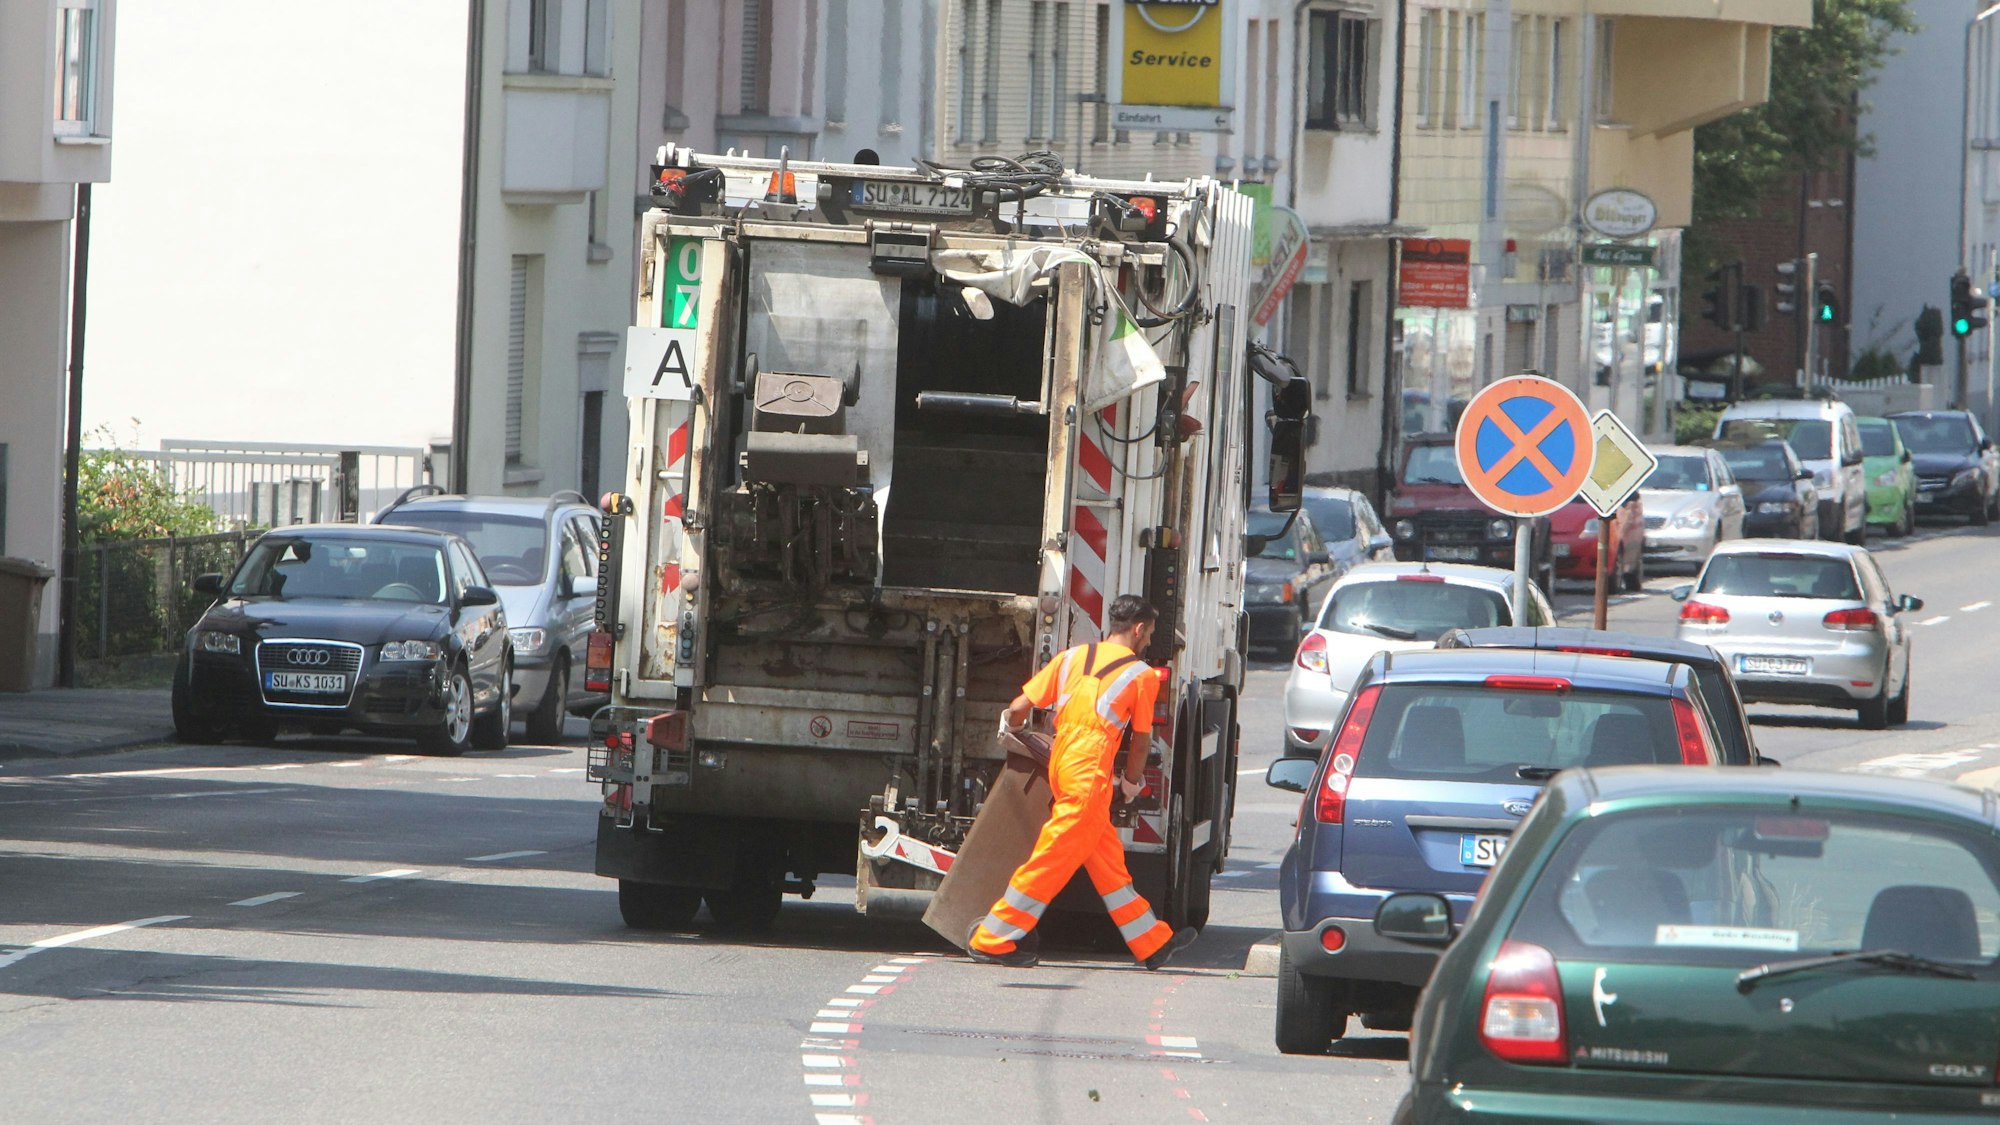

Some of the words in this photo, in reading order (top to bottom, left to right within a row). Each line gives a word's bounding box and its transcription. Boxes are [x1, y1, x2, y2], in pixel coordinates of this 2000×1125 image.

[1130, 50, 1212, 68] Service
[1118, 112, 1162, 124] Einfahrt
[864, 183, 887, 203] SU
[900, 186, 922, 206] AL
[928, 186, 971, 209] 7124
[651, 339, 693, 388] A
[273, 674, 288, 688] SU
[296, 674, 311, 689] KS
[314, 675, 343, 690] 1031
[1591, 1046, 1668, 1065] MITSUBISHI
[1929, 1064, 1987, 1078] COLT
